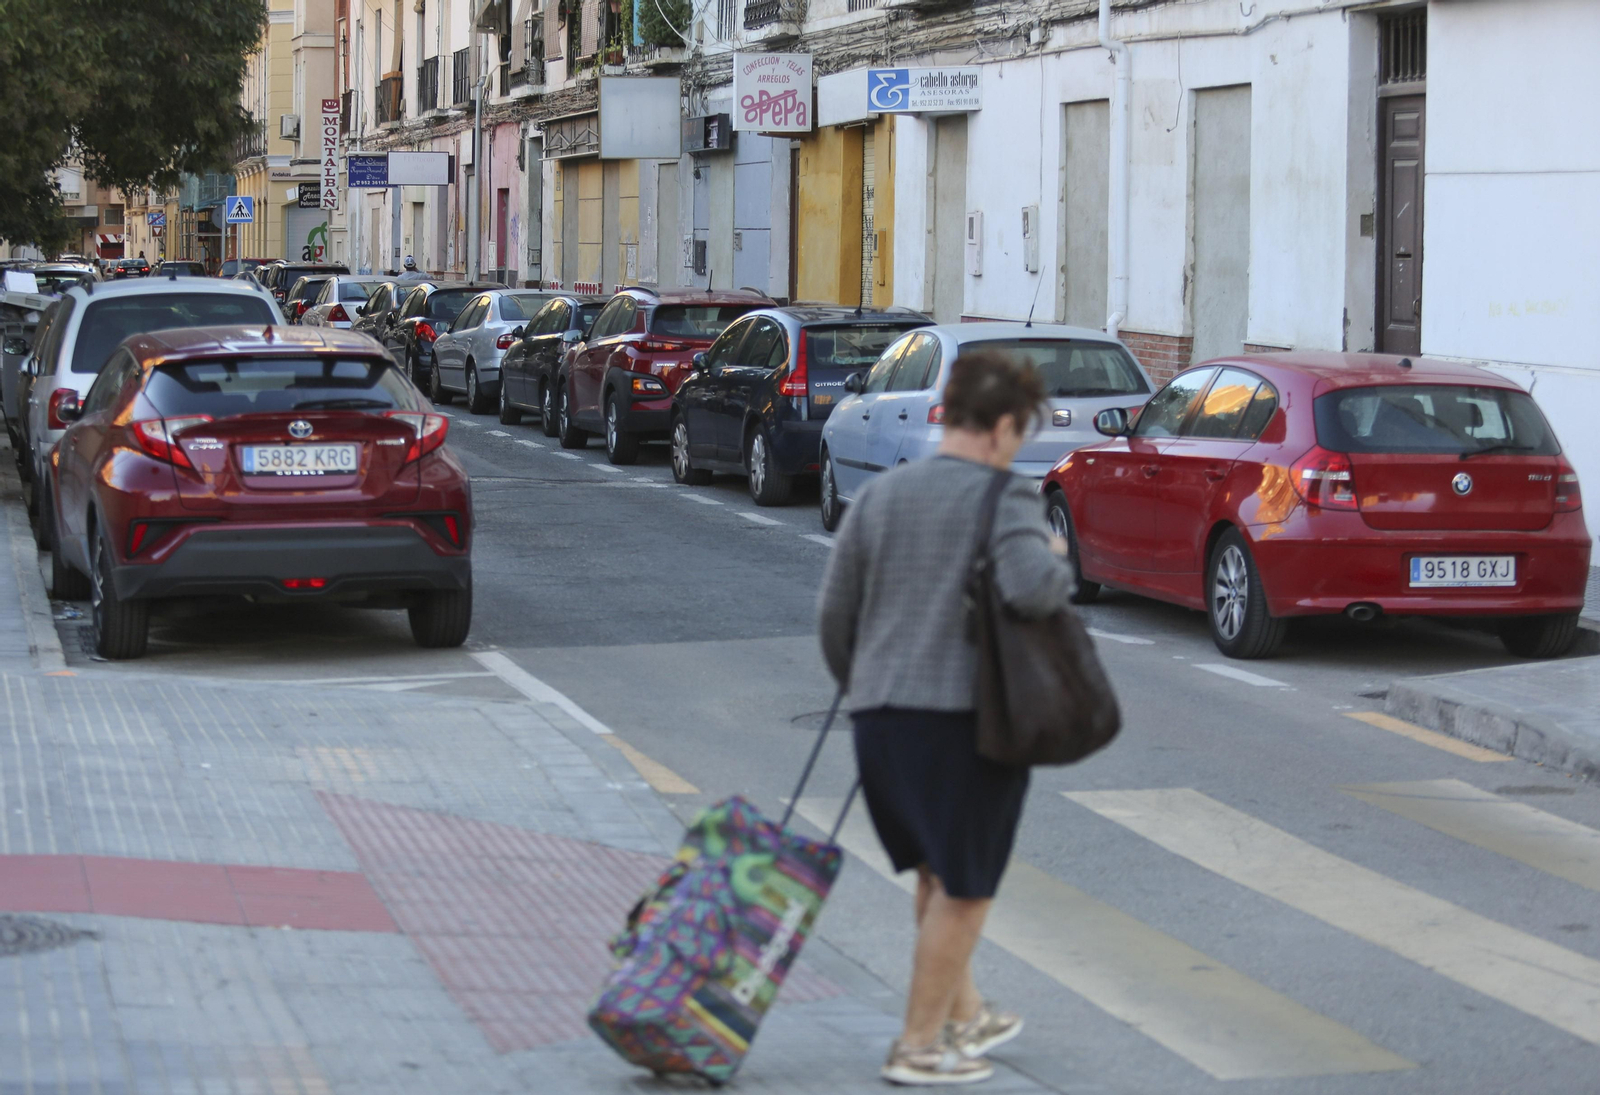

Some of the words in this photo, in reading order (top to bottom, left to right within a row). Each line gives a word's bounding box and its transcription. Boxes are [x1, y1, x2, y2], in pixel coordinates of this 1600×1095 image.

[742, 56, 780, 76] CONFECCION
[786, 60, 805, 77] TELAS
[757, 74, 790, 84] ARREGLOS
[920, 72, 948, 88] cabello
[950, 71, 978, 89] astorga
[920, 88, 970, 97] ASESORAS
[322, 116, 339, 208] MONTALBAN
[258, 449, 307, 467] 5882
[315, 449, 351, 467] KRG
[1425, 560, 1470, 579] 9518
[1478, 560, 1509, 578] GXJ
